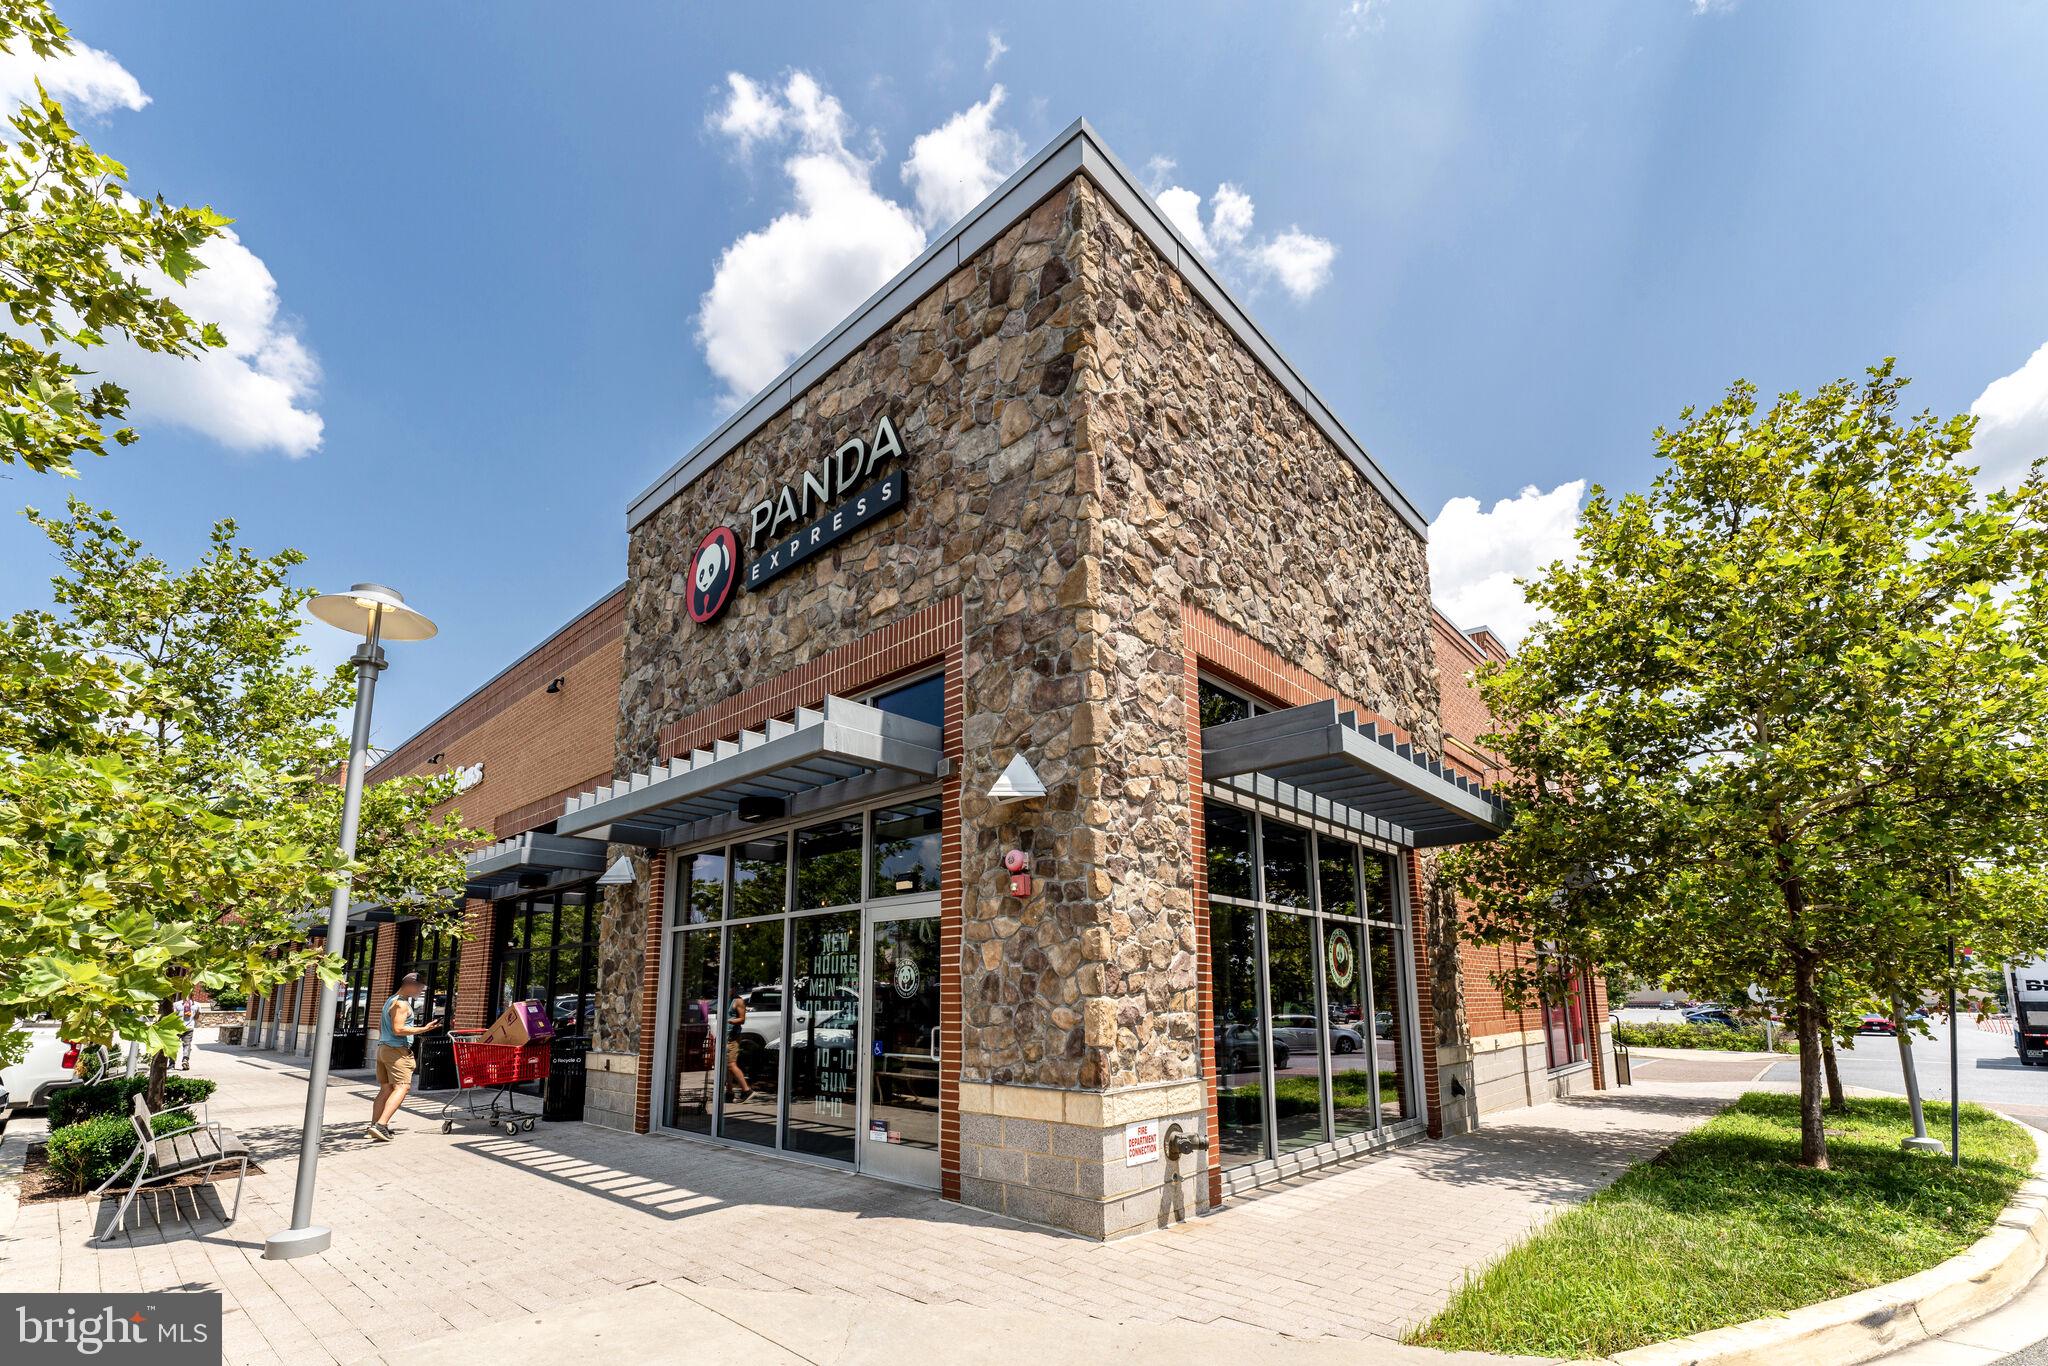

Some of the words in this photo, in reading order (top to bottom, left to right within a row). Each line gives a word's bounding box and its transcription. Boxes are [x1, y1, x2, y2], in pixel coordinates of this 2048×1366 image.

[750, 415, 903, 549] PANDA
[751, 482, 892, 581] EXPRESS
[822, 933, 850, 952] NEW
[813, 954, 858, 975] HOURS
[820, 1071, 847, 1093] SUN
[1137, 1126, 1148, 1135] FIRE
[1128, 1134, 1157, 1148] DEPARTMENT
[1128, 1144, 1157, 1158] CONNECTION
